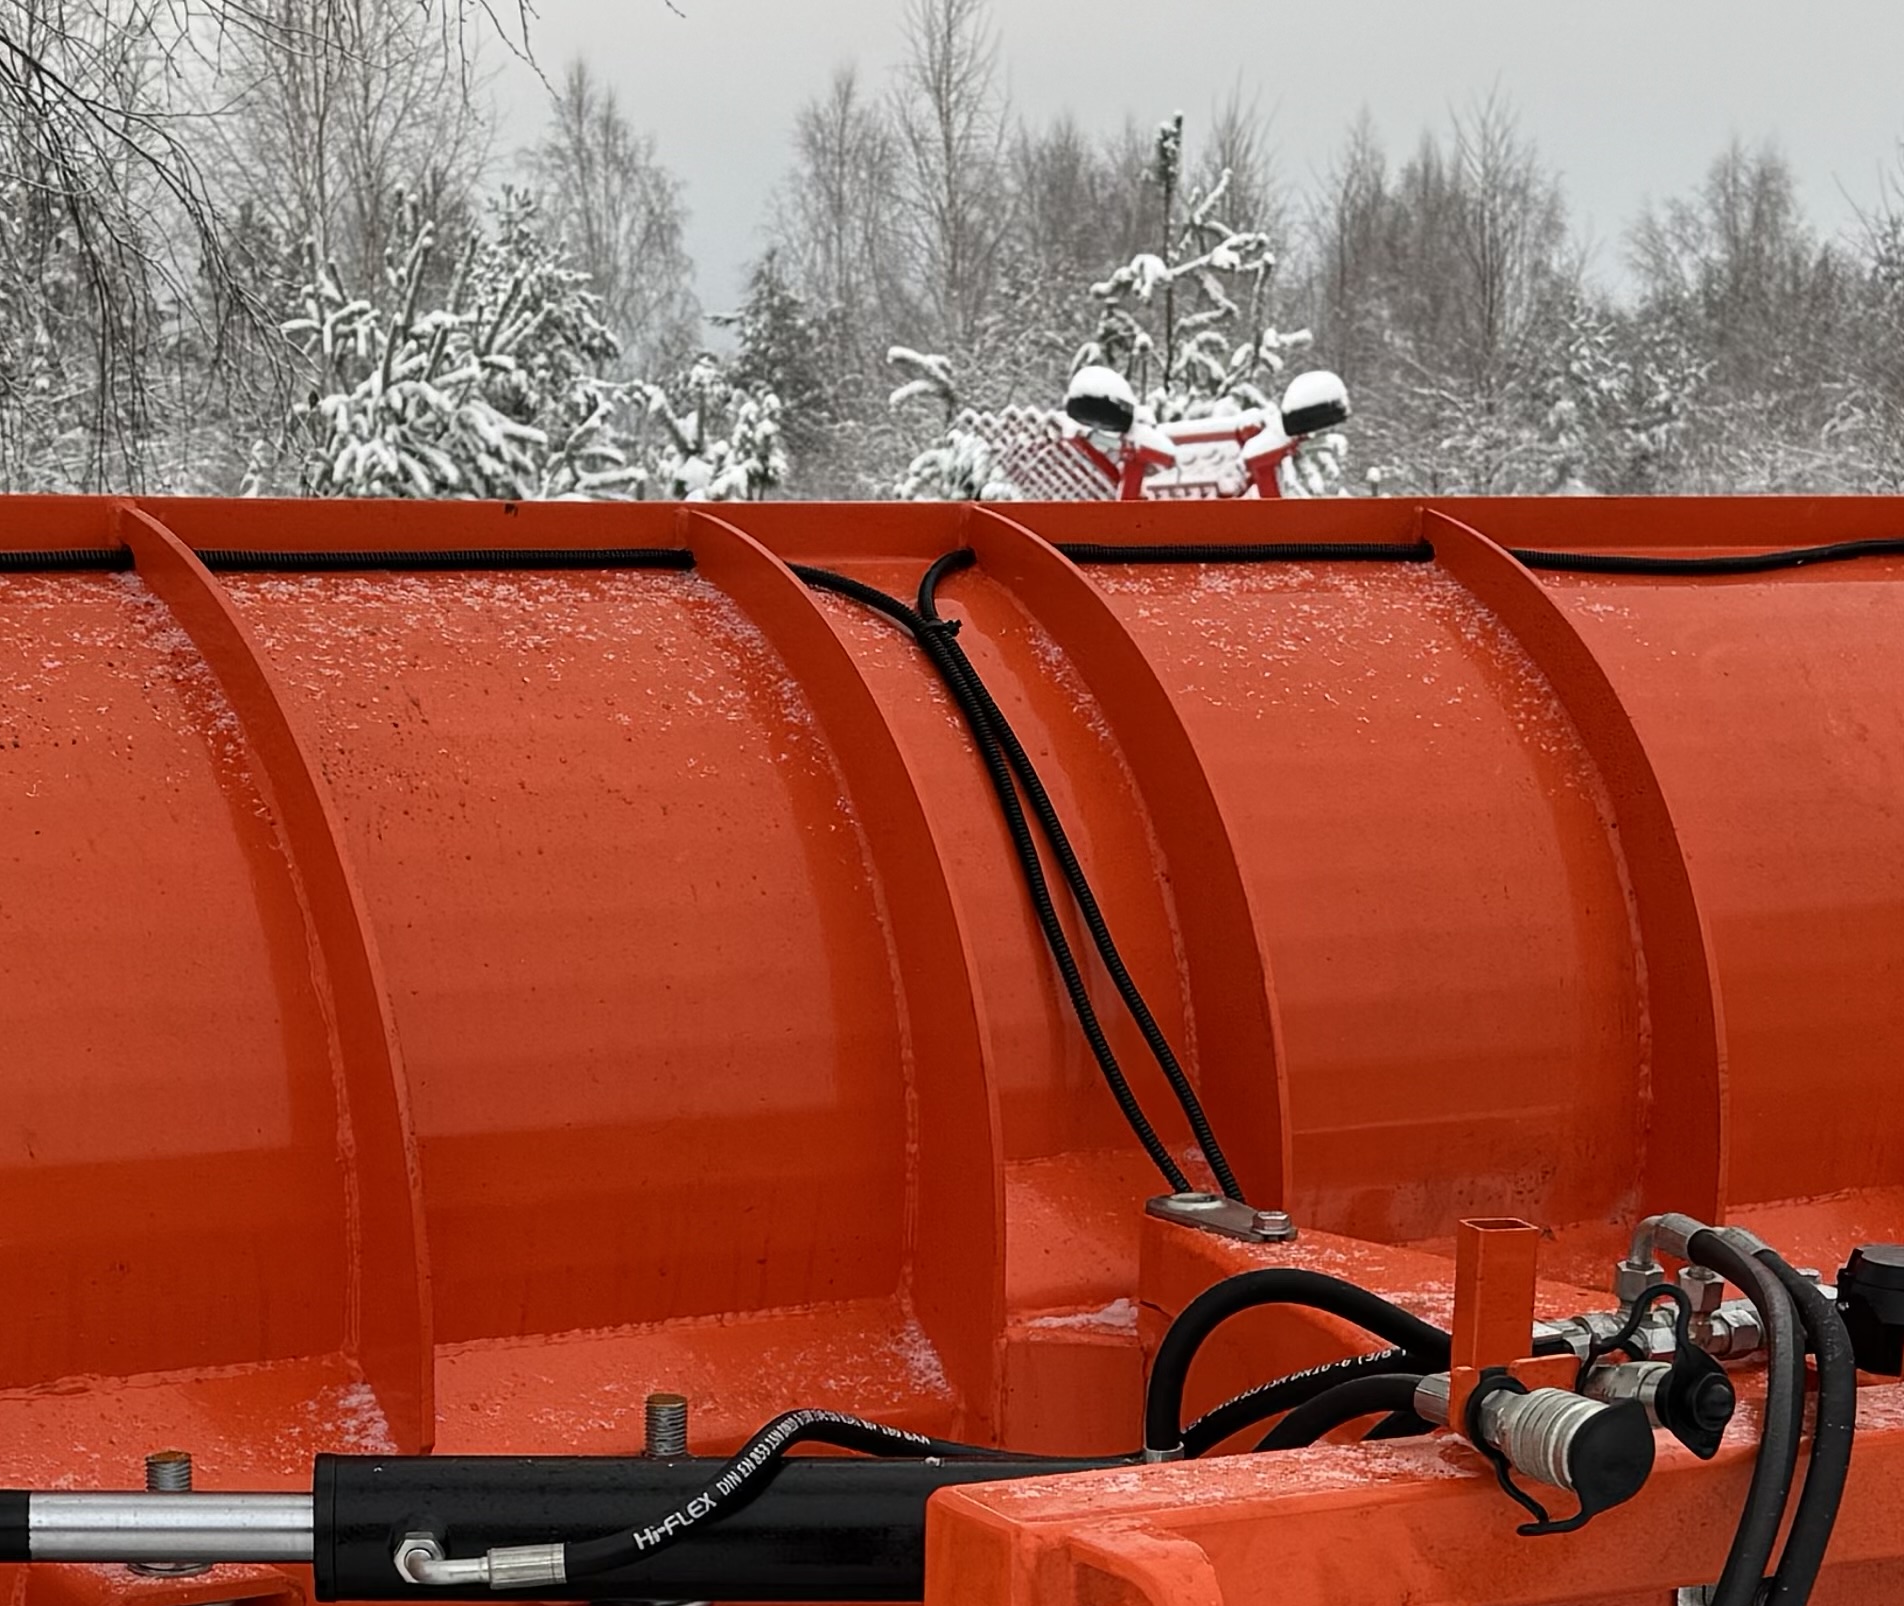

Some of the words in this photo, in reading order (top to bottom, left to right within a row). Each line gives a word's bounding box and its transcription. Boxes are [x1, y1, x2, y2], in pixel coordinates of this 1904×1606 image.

[633, 1492, 717, 1550] Hi-FLEX
[715, 1470, 742, 1496] DIN
[737, 1457, 756, 1478] EN
